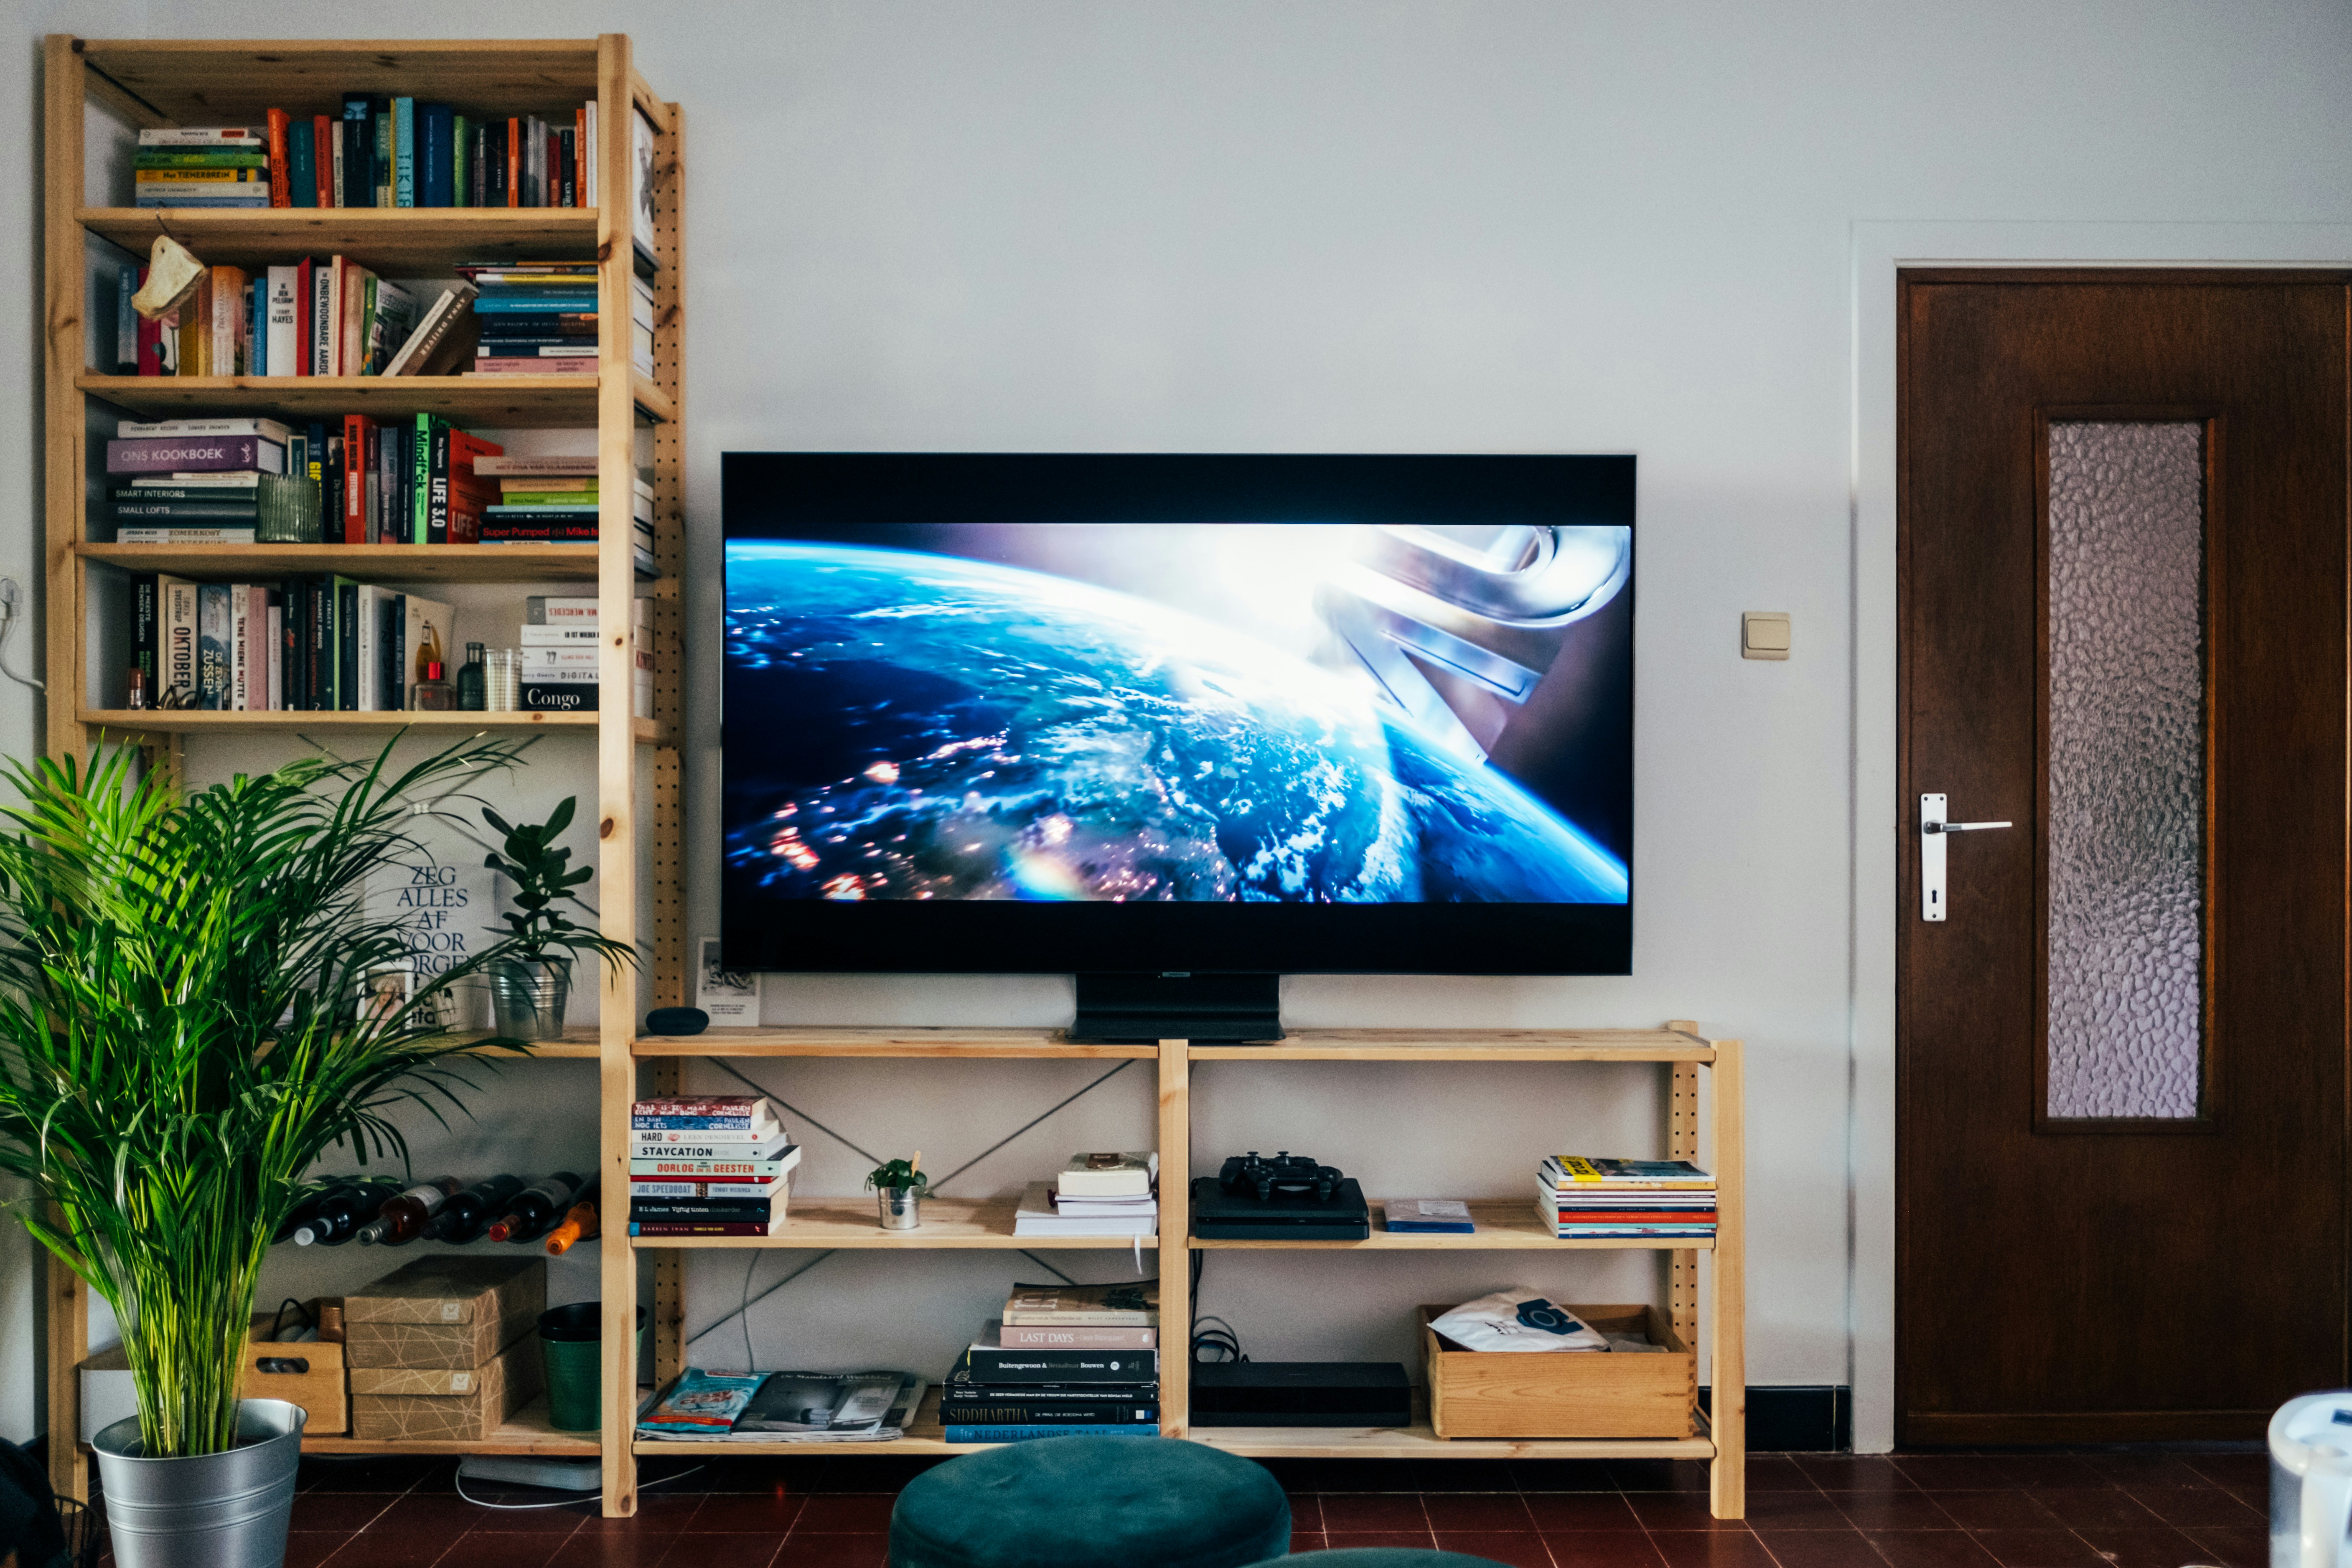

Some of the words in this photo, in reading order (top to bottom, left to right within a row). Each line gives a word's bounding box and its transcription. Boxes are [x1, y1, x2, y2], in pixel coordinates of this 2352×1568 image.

[320, 279, 329, 346] ONBEWOONBARE
[446, 297, 465, 320] ANNA
[319, 349, 329, 375] AARDE
[121, 451, 148, 461] ONS
[152, 448, 224, 460] KOOKBOEK
[432, 478, 446, 503] LIFE
[432, 507, 445, 528] 3.0
[483, 527, 510, 538] Super
[512, 527, 550, 537] Pumped
[566, 527, 589, 536] Mike
[173, 627, 191, 688] OKTOBER
[215, 652, 222, 663] DE
[203, 649, 214, 694] ZUSSEN
[237, 669, 245, 699] MUTTE
[527, 688, 581, 710] Congo
[411, 866, 455, 885] ZEG
[397, 888, 468, 907] ALLES
[418, 910, 448, 929] AF
[397, 932, 467, 952] VOOR
[641, 1132, 662, 1141] HARD
[642, 1147, 713, 1156] STAYCATION
[657, 1164, 694, 1173] OORLOG
[713, 1164, 754, 1173] GEESTEN
[637, 1184, 651, 1193] JOE
[651, 1185, 691, 1193] SPEEDBOAT
[1020, 1333, 1046, 1342] LAST
[1048, 1333, 1074, 1343] DAYS
[949, 1408, 1029, 1422] SIDDHARTHA
[974, 1430, 1069, 1440] NEDERLANDSE
